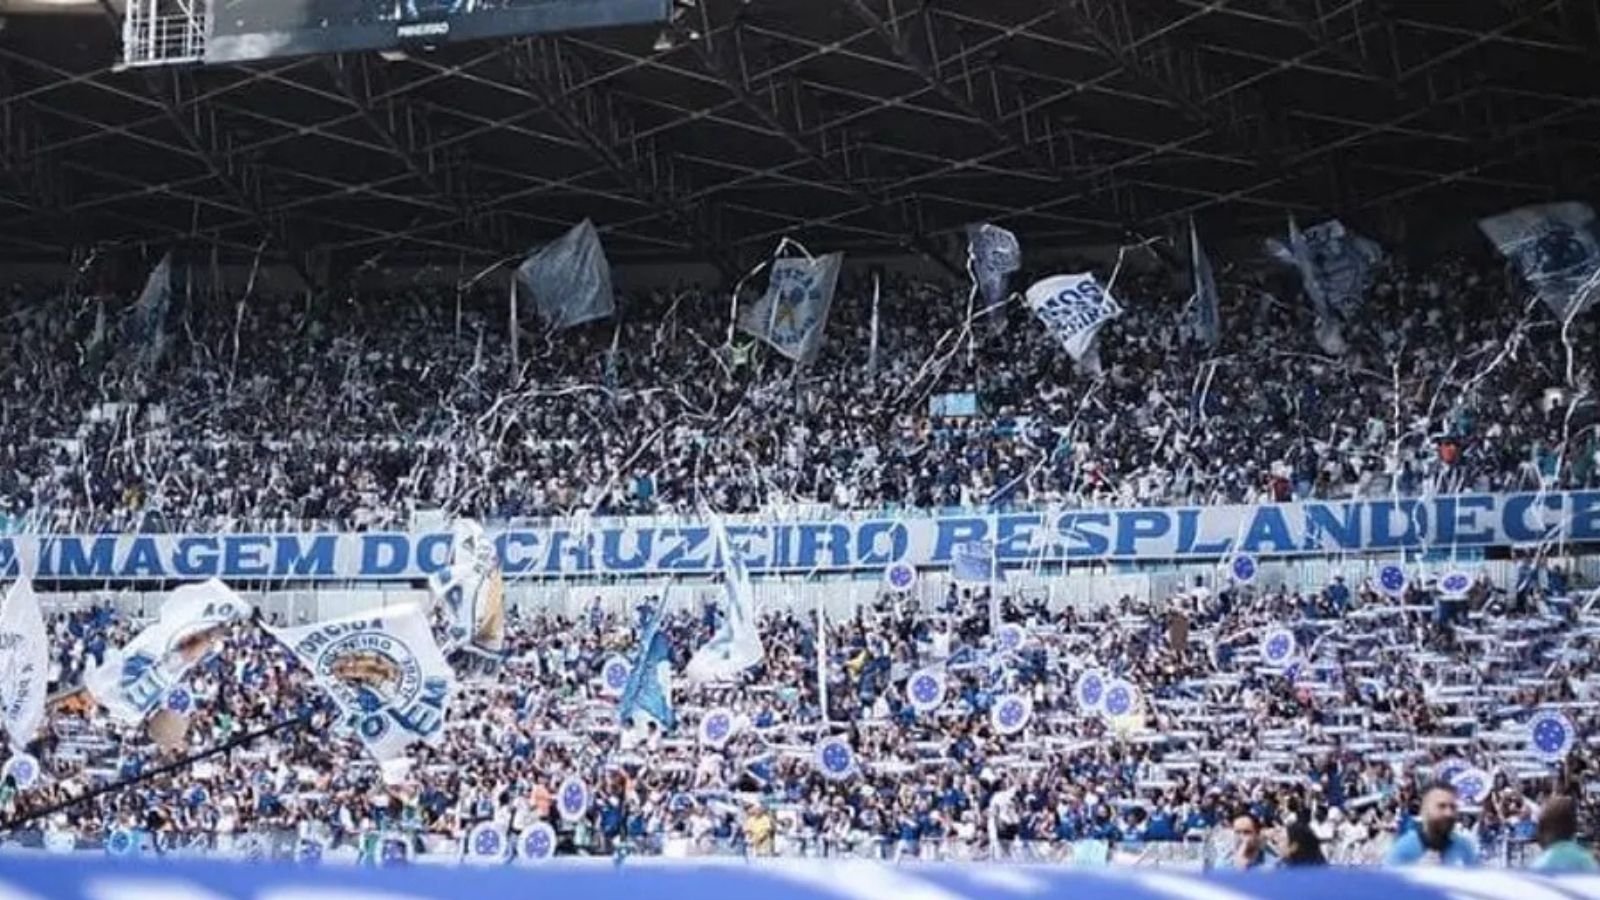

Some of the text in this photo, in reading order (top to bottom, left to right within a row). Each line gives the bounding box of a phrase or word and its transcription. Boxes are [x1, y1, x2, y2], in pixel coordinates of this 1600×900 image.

[36, 536, 336, 576] IMAGEM
[361, 534, 454, 574] DO
[494, 523, 908, 572] CRUZEIRO
